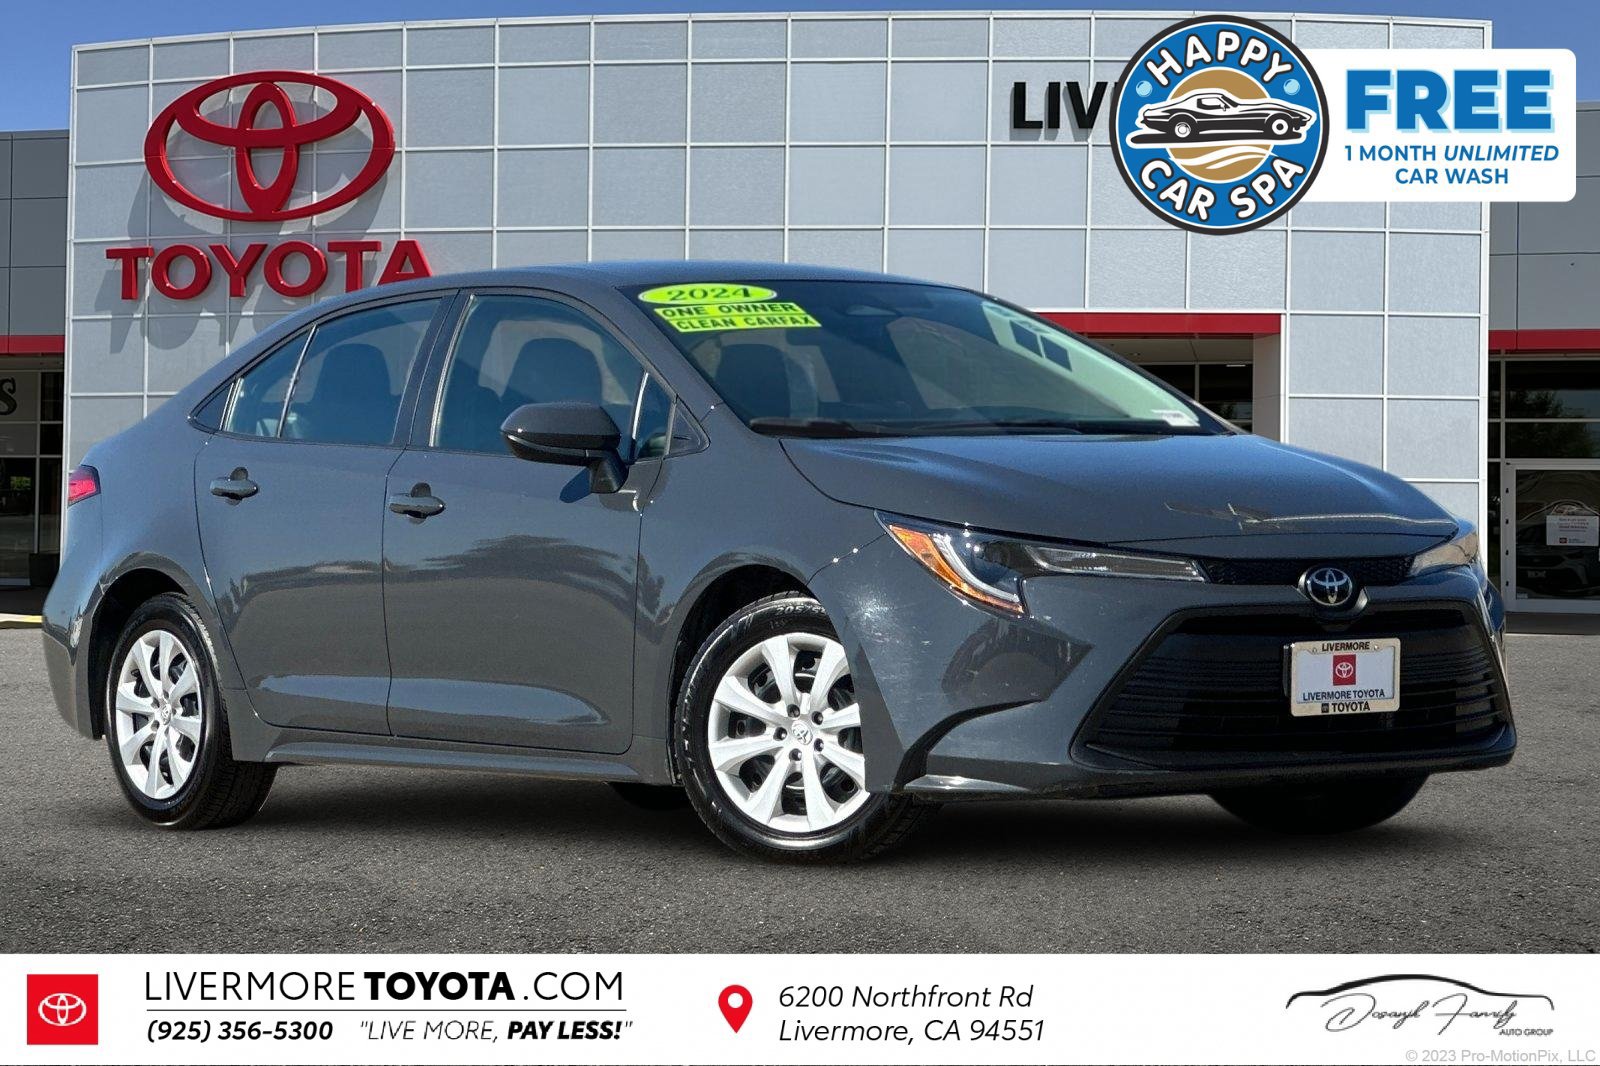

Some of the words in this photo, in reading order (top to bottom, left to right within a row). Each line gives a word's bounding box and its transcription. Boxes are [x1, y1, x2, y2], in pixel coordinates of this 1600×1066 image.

[1013, 81, 1118, 129] LIV
[105, 239, 433, 300] TOYOTA
[666, 287, 752, 301] 2024
[662, 305, 708, 317] ONE
[718, 303, 801, 314] OWNER
[676, 317, 737, 330] CLEAN
[743, 315, 816, 327] CARFAX
[1321, 641, 1370, 652] LIVERMORE
[1302, 690, 1352, 701] LIVERMORE
[1353, 688, 1385, 699] TOYOTA
[1331, 701, 1370, 712] TOYOTA
